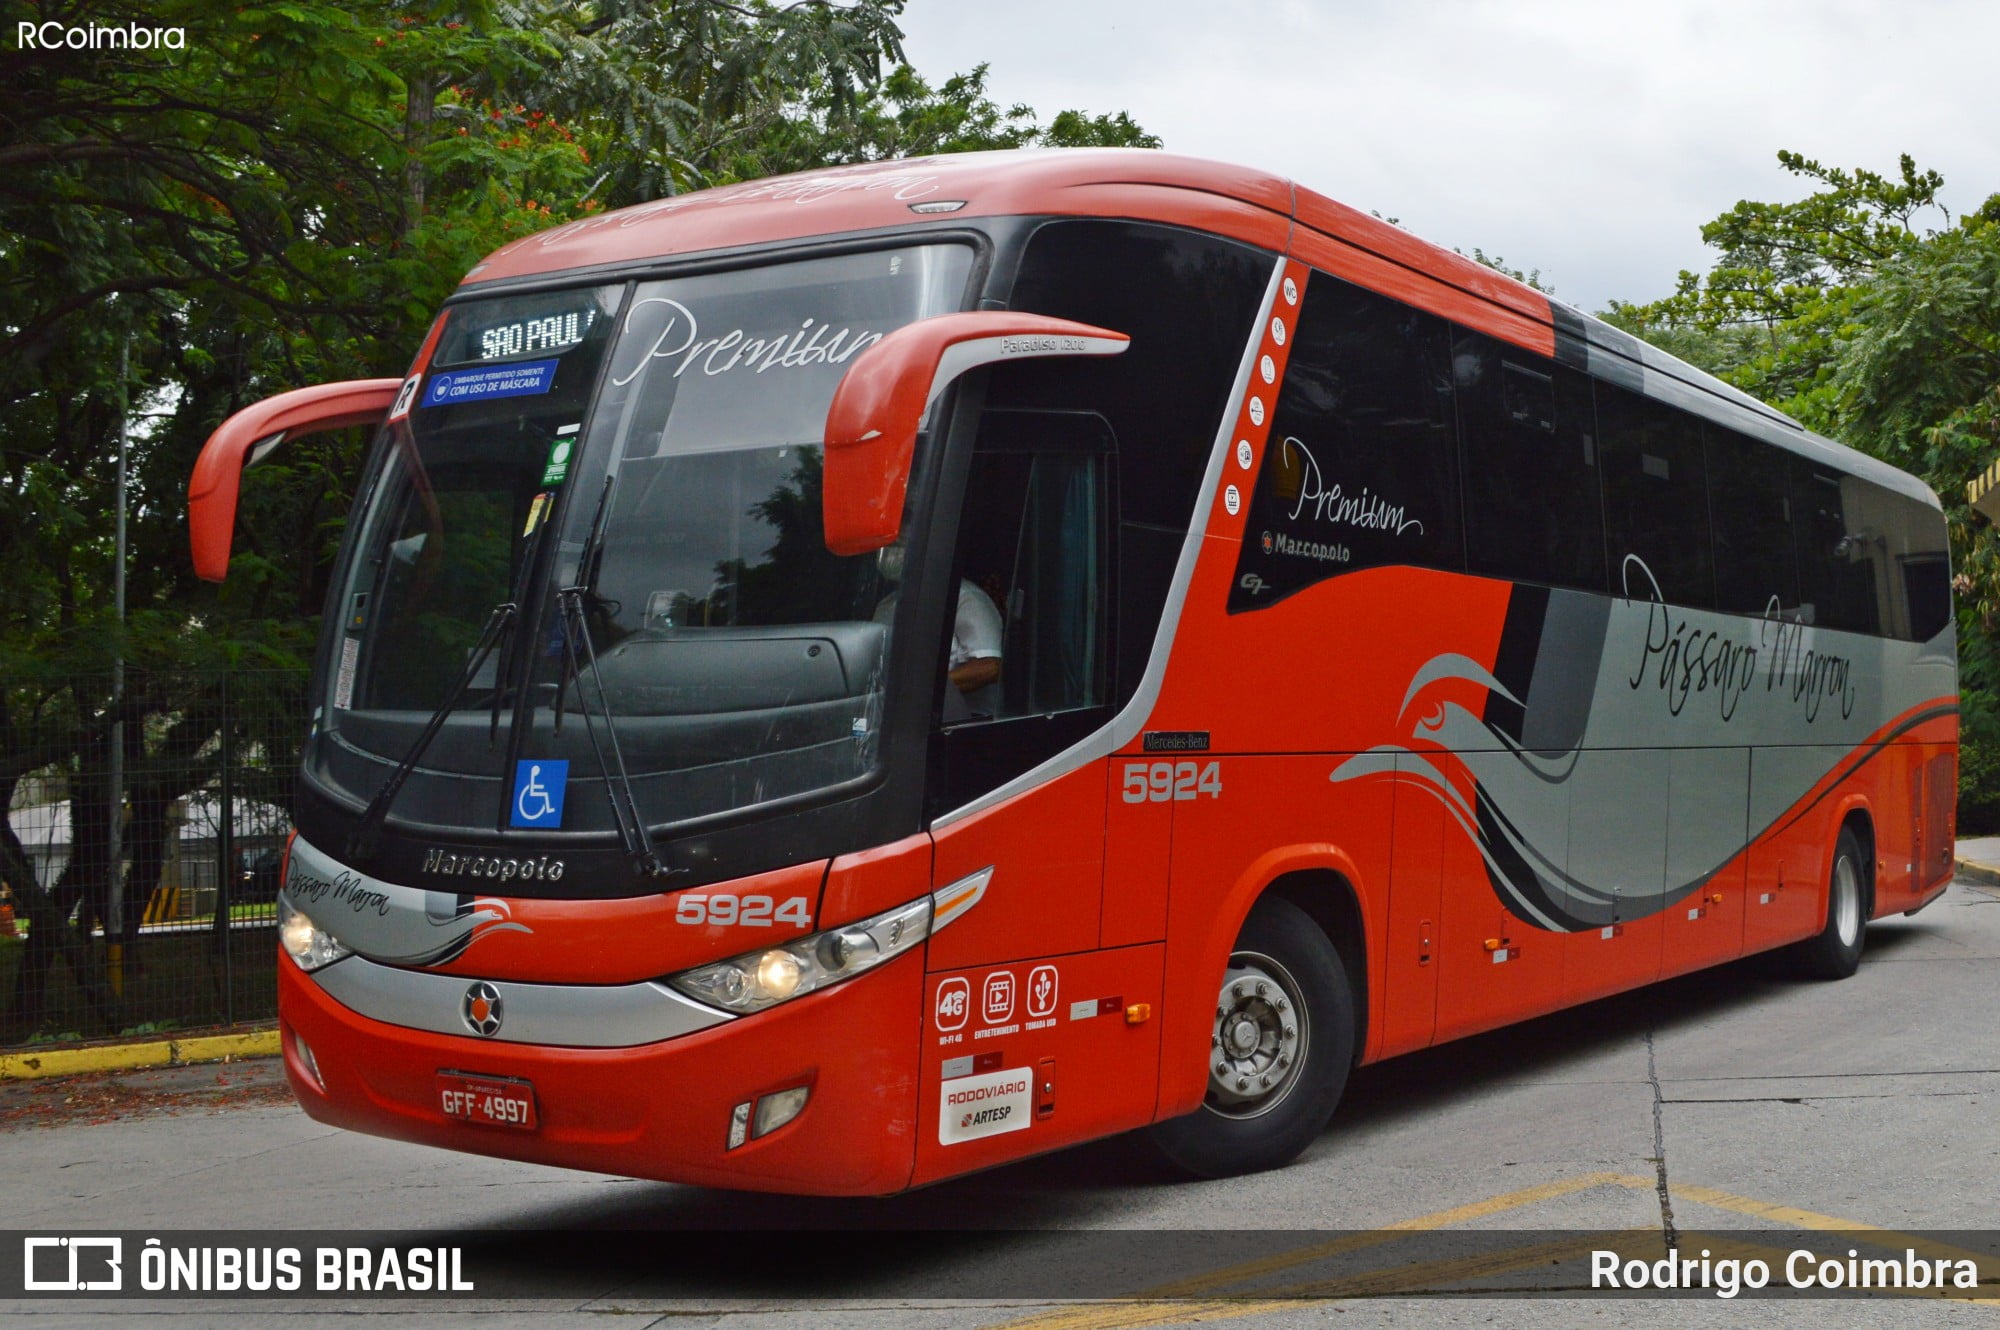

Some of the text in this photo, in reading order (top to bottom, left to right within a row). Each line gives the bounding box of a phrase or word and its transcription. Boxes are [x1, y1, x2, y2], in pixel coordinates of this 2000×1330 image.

[1284, 284, 1297, 299] WC
[526, 309, 596, 351] PAUL
[1000, 337, 1086, 355] Paradiso 1200
[449, 377, 540, 397] COM USO DE MÁSCARA
[453, 367, 545, 385] EMBARQUE PERMITIDO SOMENTE
[1283, 436, 1424, 536] Premium
[1275, 532, 1350, 562] Marcopolo
[1622, 553, 1855, 724] Pássaro Marron
[1146, 734, 1208, 750] Mercedes-Benz
[1122, 761, 1222, 804] 5924
[422, 848, 566, 882] Marcopolo
[334, 868, 390, 917] Marron
[675, 894, 811, 928] 5924
[1025, 1020, 1046, 1031] TOMADA
[947, 1080, 1026, 1106] RODOVIÁRIO
[973, 1106, 1011, 1126] ARTESP
